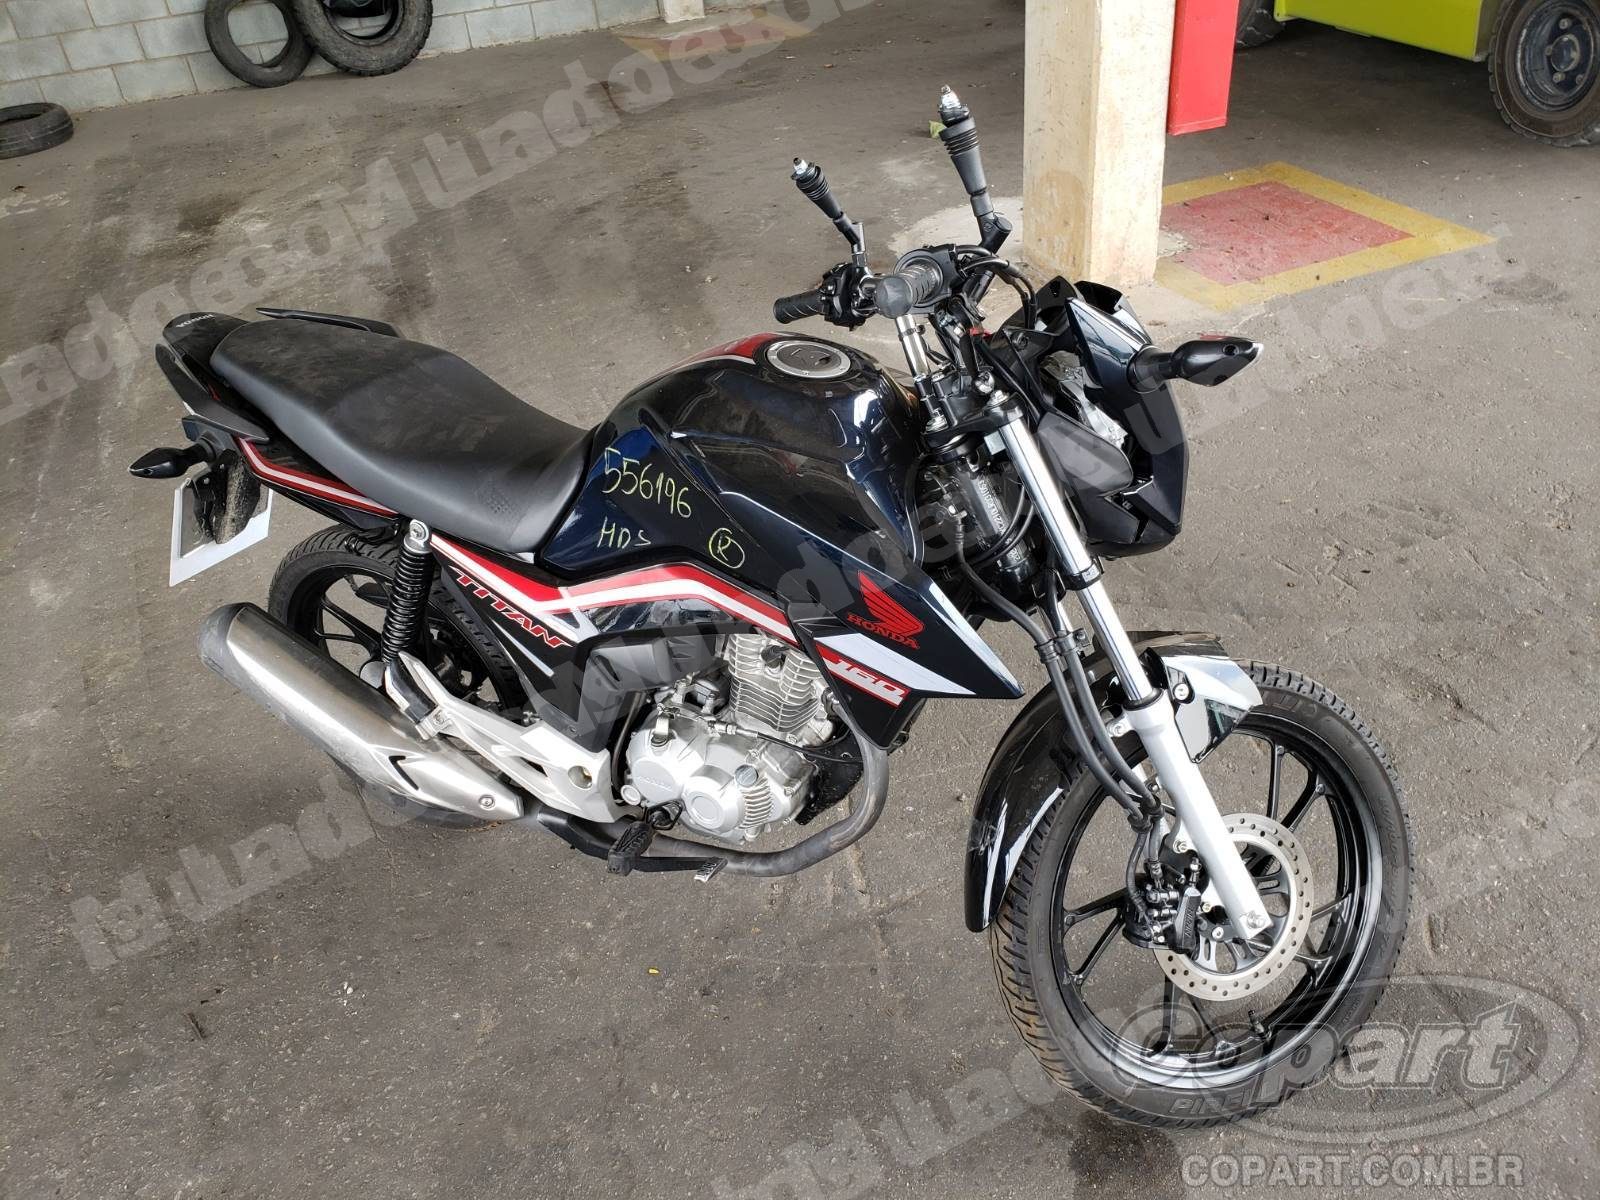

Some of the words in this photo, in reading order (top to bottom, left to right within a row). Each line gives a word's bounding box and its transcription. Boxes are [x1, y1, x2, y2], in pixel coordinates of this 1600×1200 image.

[602, 447, 692, 518] 556196
[596, 516, 652, 549] HDS
[448, 565, 574, 649] TITAN
[847, 612, 921, 650] HONDA
[822, 657, 906, 706] 160
